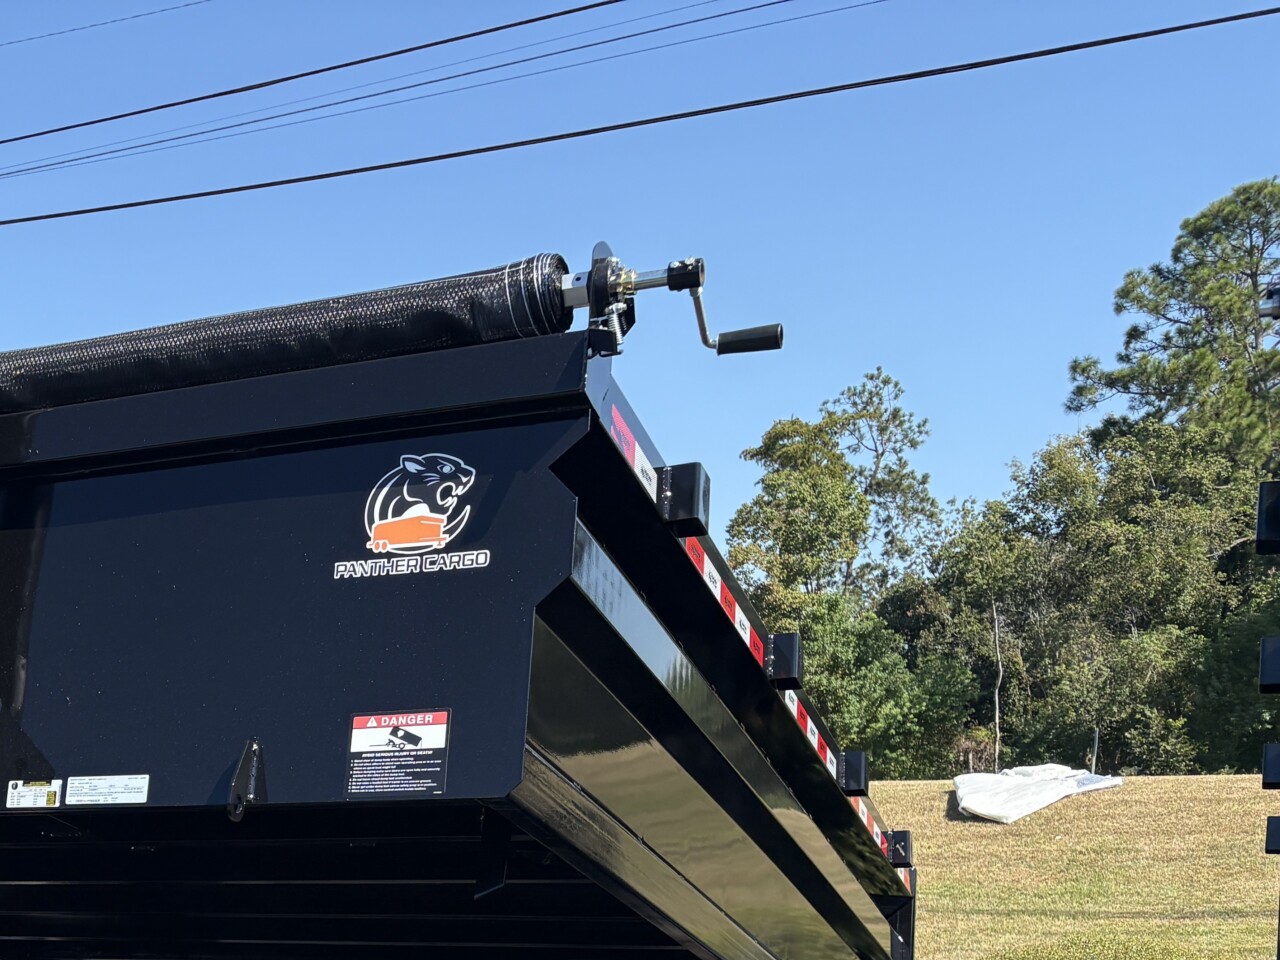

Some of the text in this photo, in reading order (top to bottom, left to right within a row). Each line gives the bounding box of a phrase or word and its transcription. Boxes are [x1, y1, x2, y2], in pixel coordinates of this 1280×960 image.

[334, 550, 490, 579] PANTHER CARGO
[381, 714, 433, 726] DANGER
